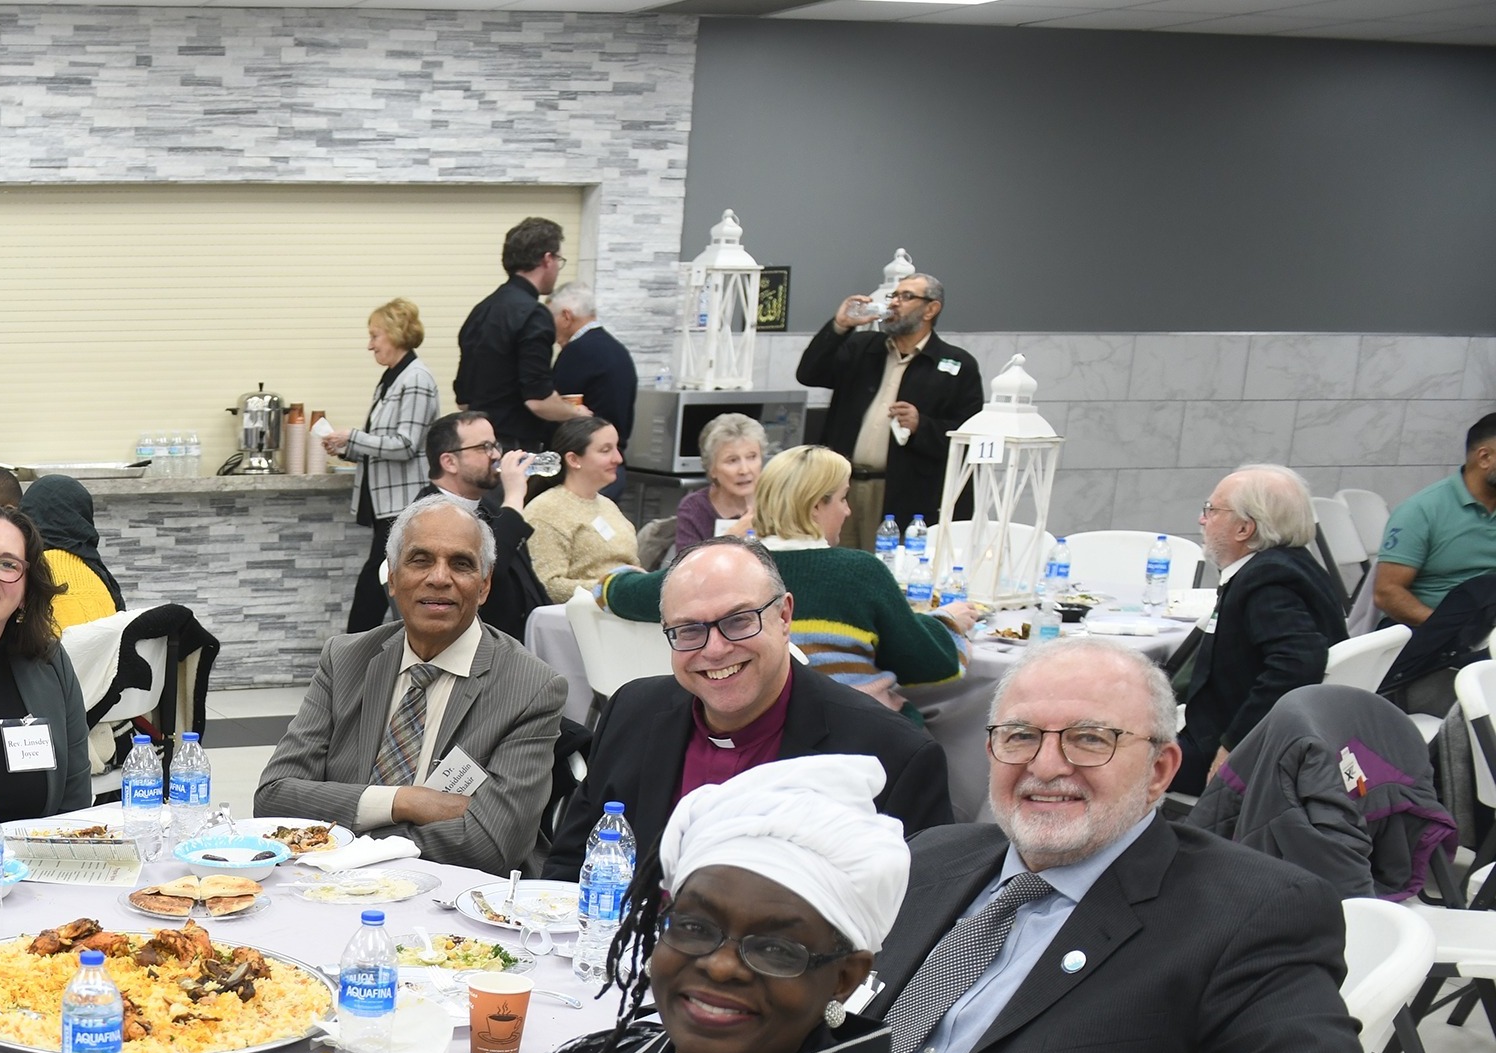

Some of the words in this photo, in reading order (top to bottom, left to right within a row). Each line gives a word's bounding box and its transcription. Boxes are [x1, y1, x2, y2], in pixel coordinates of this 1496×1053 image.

[978, 441, 994, 458] 11
[1384, 527, 1403, 550] 3
[22, 750, 39, 759] Joyce
[442, 768, 455, 777] Dr.
[133, 789, 162, 799] AQUAFIN
[457, 777, 474, 795] Shakir
[346, 985, 392, 1000] AQUAFINA
[75, 1029, 121, 1046] AQUAFINA
